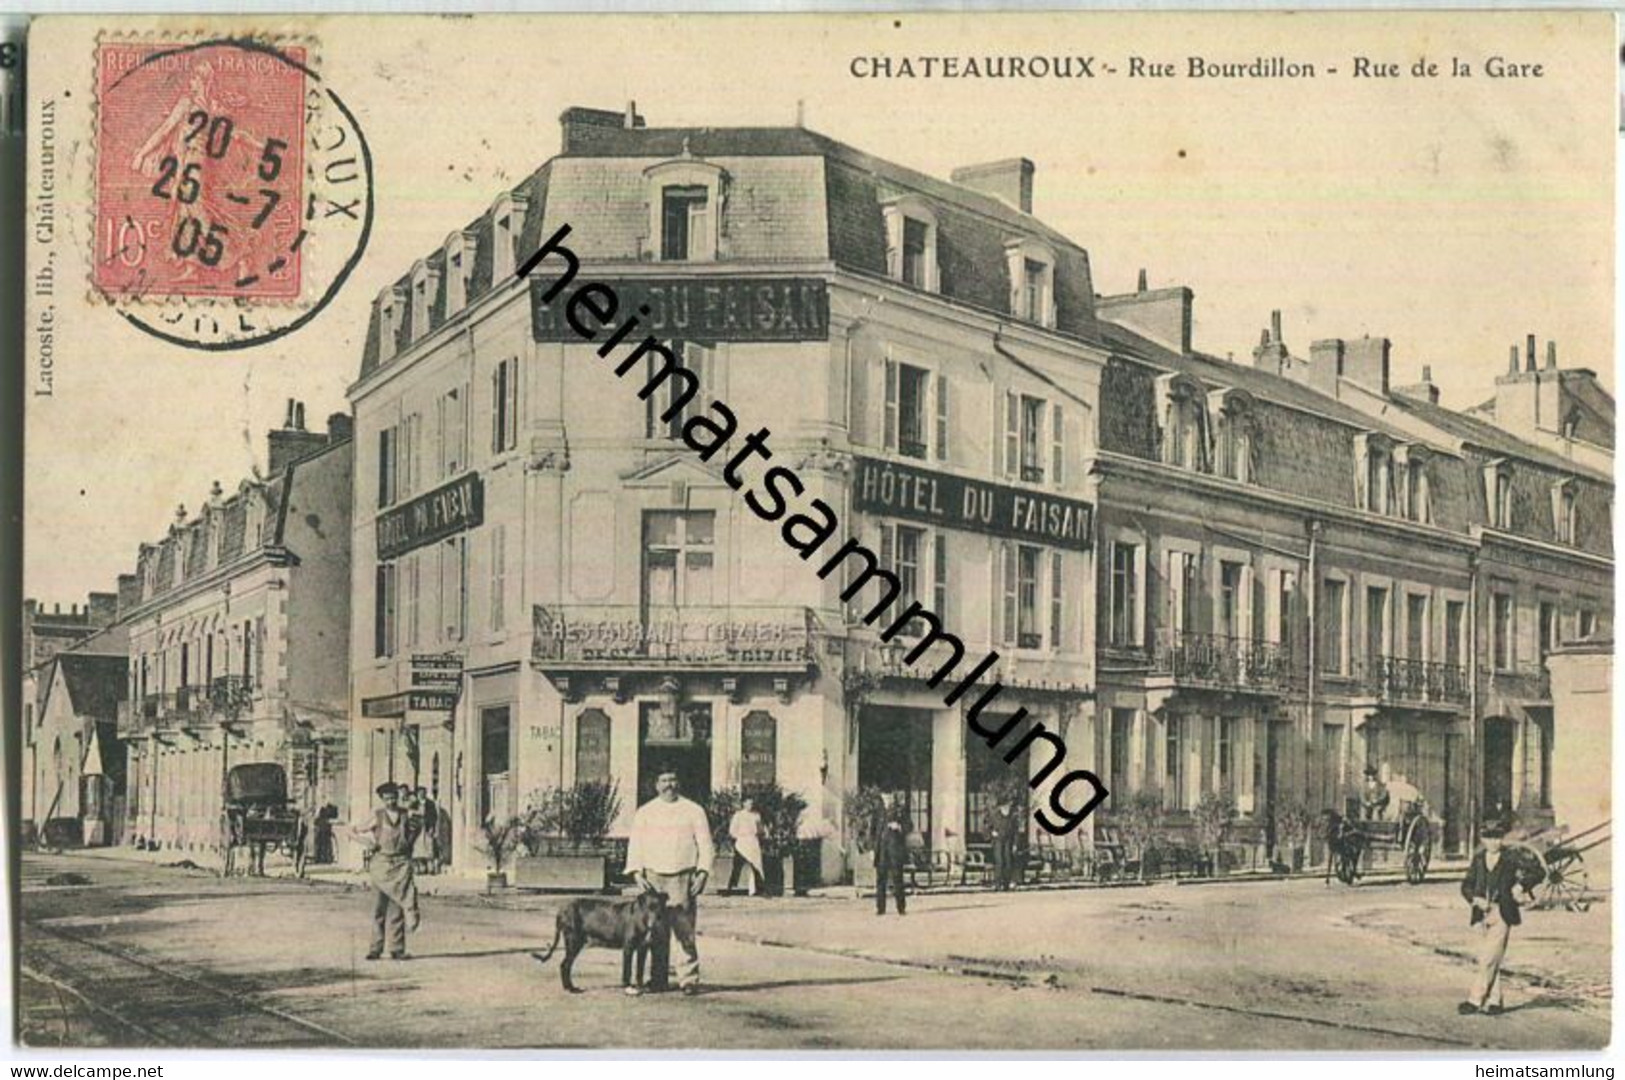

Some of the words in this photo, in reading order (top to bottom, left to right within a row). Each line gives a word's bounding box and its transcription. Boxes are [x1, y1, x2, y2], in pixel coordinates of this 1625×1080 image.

[184, 111, 233, 159] 20
[259, 137, 288, 182] 5
[172, 217, 229, 266] 05
[703, 284, 821, 331] FAISAN
[862, 462, 945, 515] HÔTEL
[962, 485, 994, 525] DU
[1011, 495, 1091, 541] FAISAN
